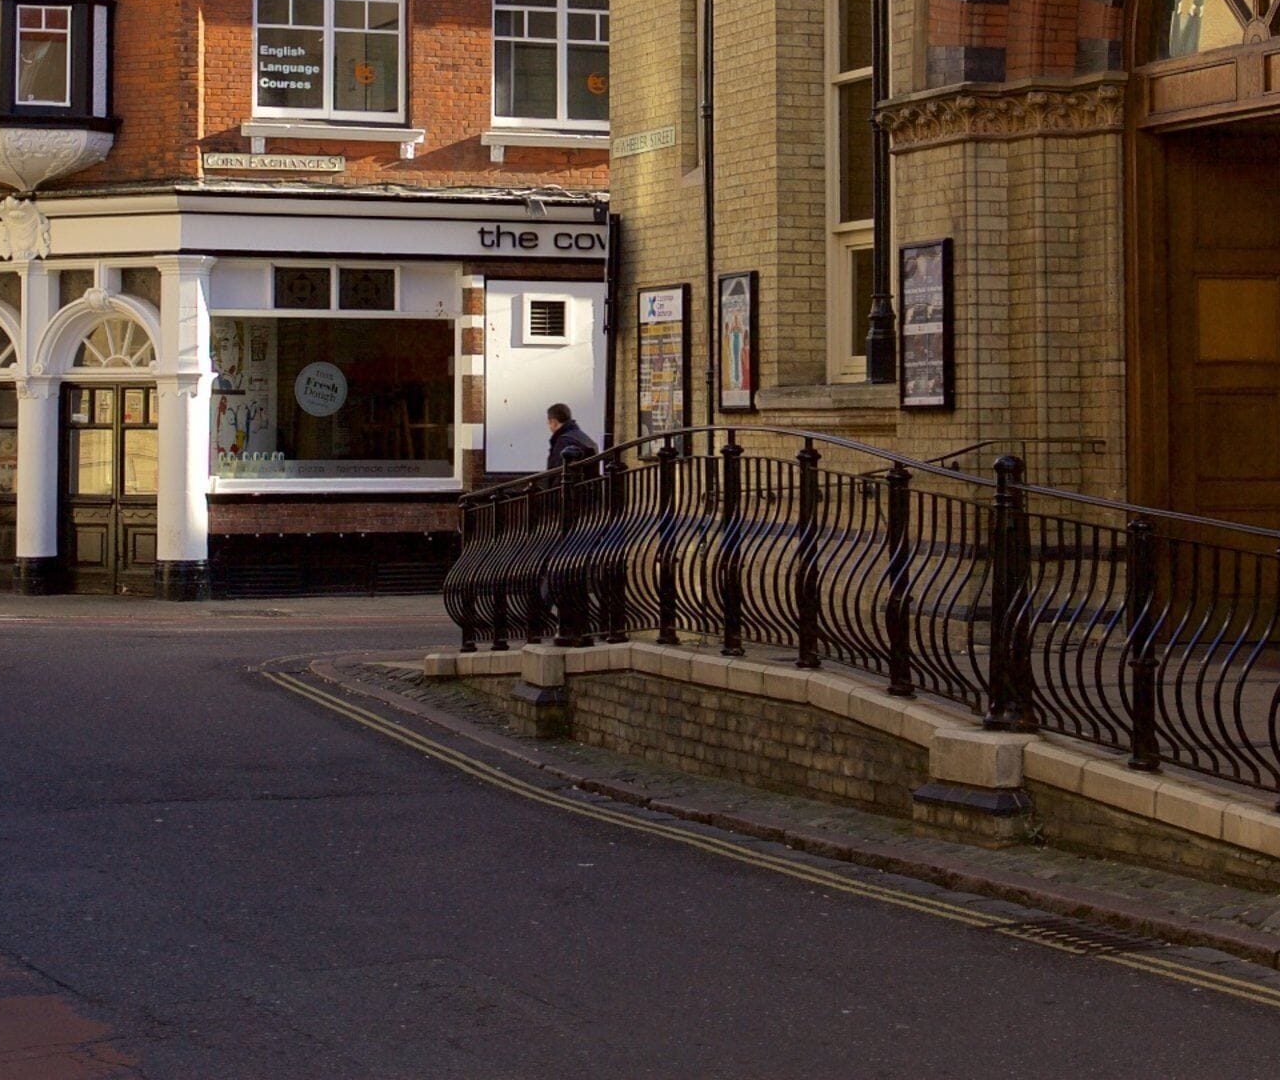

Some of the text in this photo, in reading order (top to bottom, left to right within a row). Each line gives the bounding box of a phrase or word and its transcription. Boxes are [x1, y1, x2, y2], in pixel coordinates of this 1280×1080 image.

[259, 45, 305, 58] English
[259, 61, 320, 75] Language
[259, 77, 311, 89] Courses
[650, 128, 673, 147] STREET
[206, 154, 244, 167] CORN
[249, 156, 325, 169] EXCHANGE
[478, 225, 539, 249] the
[306, 377, 338, 393] Fresh
[304, 386, 336, 403] Dough
[387, 464, 421, 473] coffee
